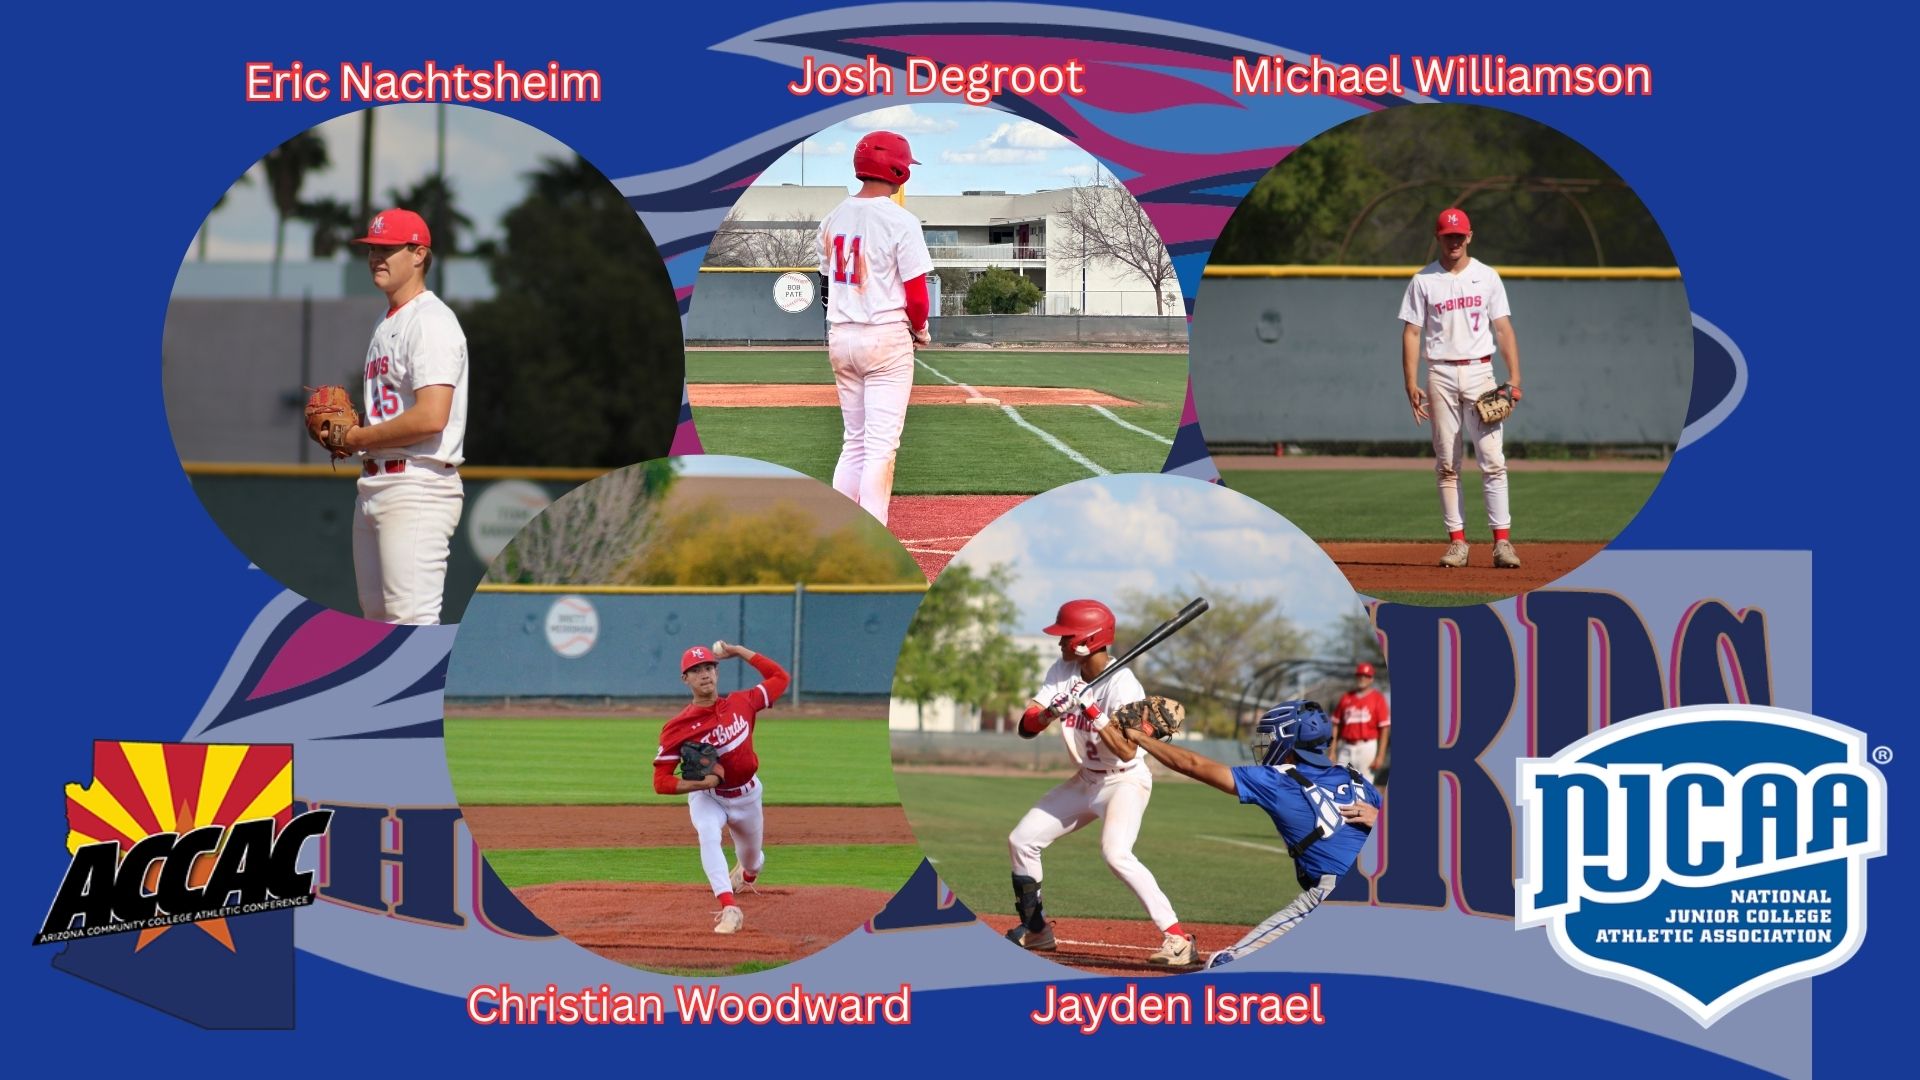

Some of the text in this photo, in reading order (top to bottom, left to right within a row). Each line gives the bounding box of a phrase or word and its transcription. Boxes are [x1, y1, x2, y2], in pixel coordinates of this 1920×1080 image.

[833, 234, 862, 286] 11
[1434, 295, 1483, 315] T-BIRDS
[1470, 312, 1480, 332] 7
[1086, 740, 1100, 761] 2
